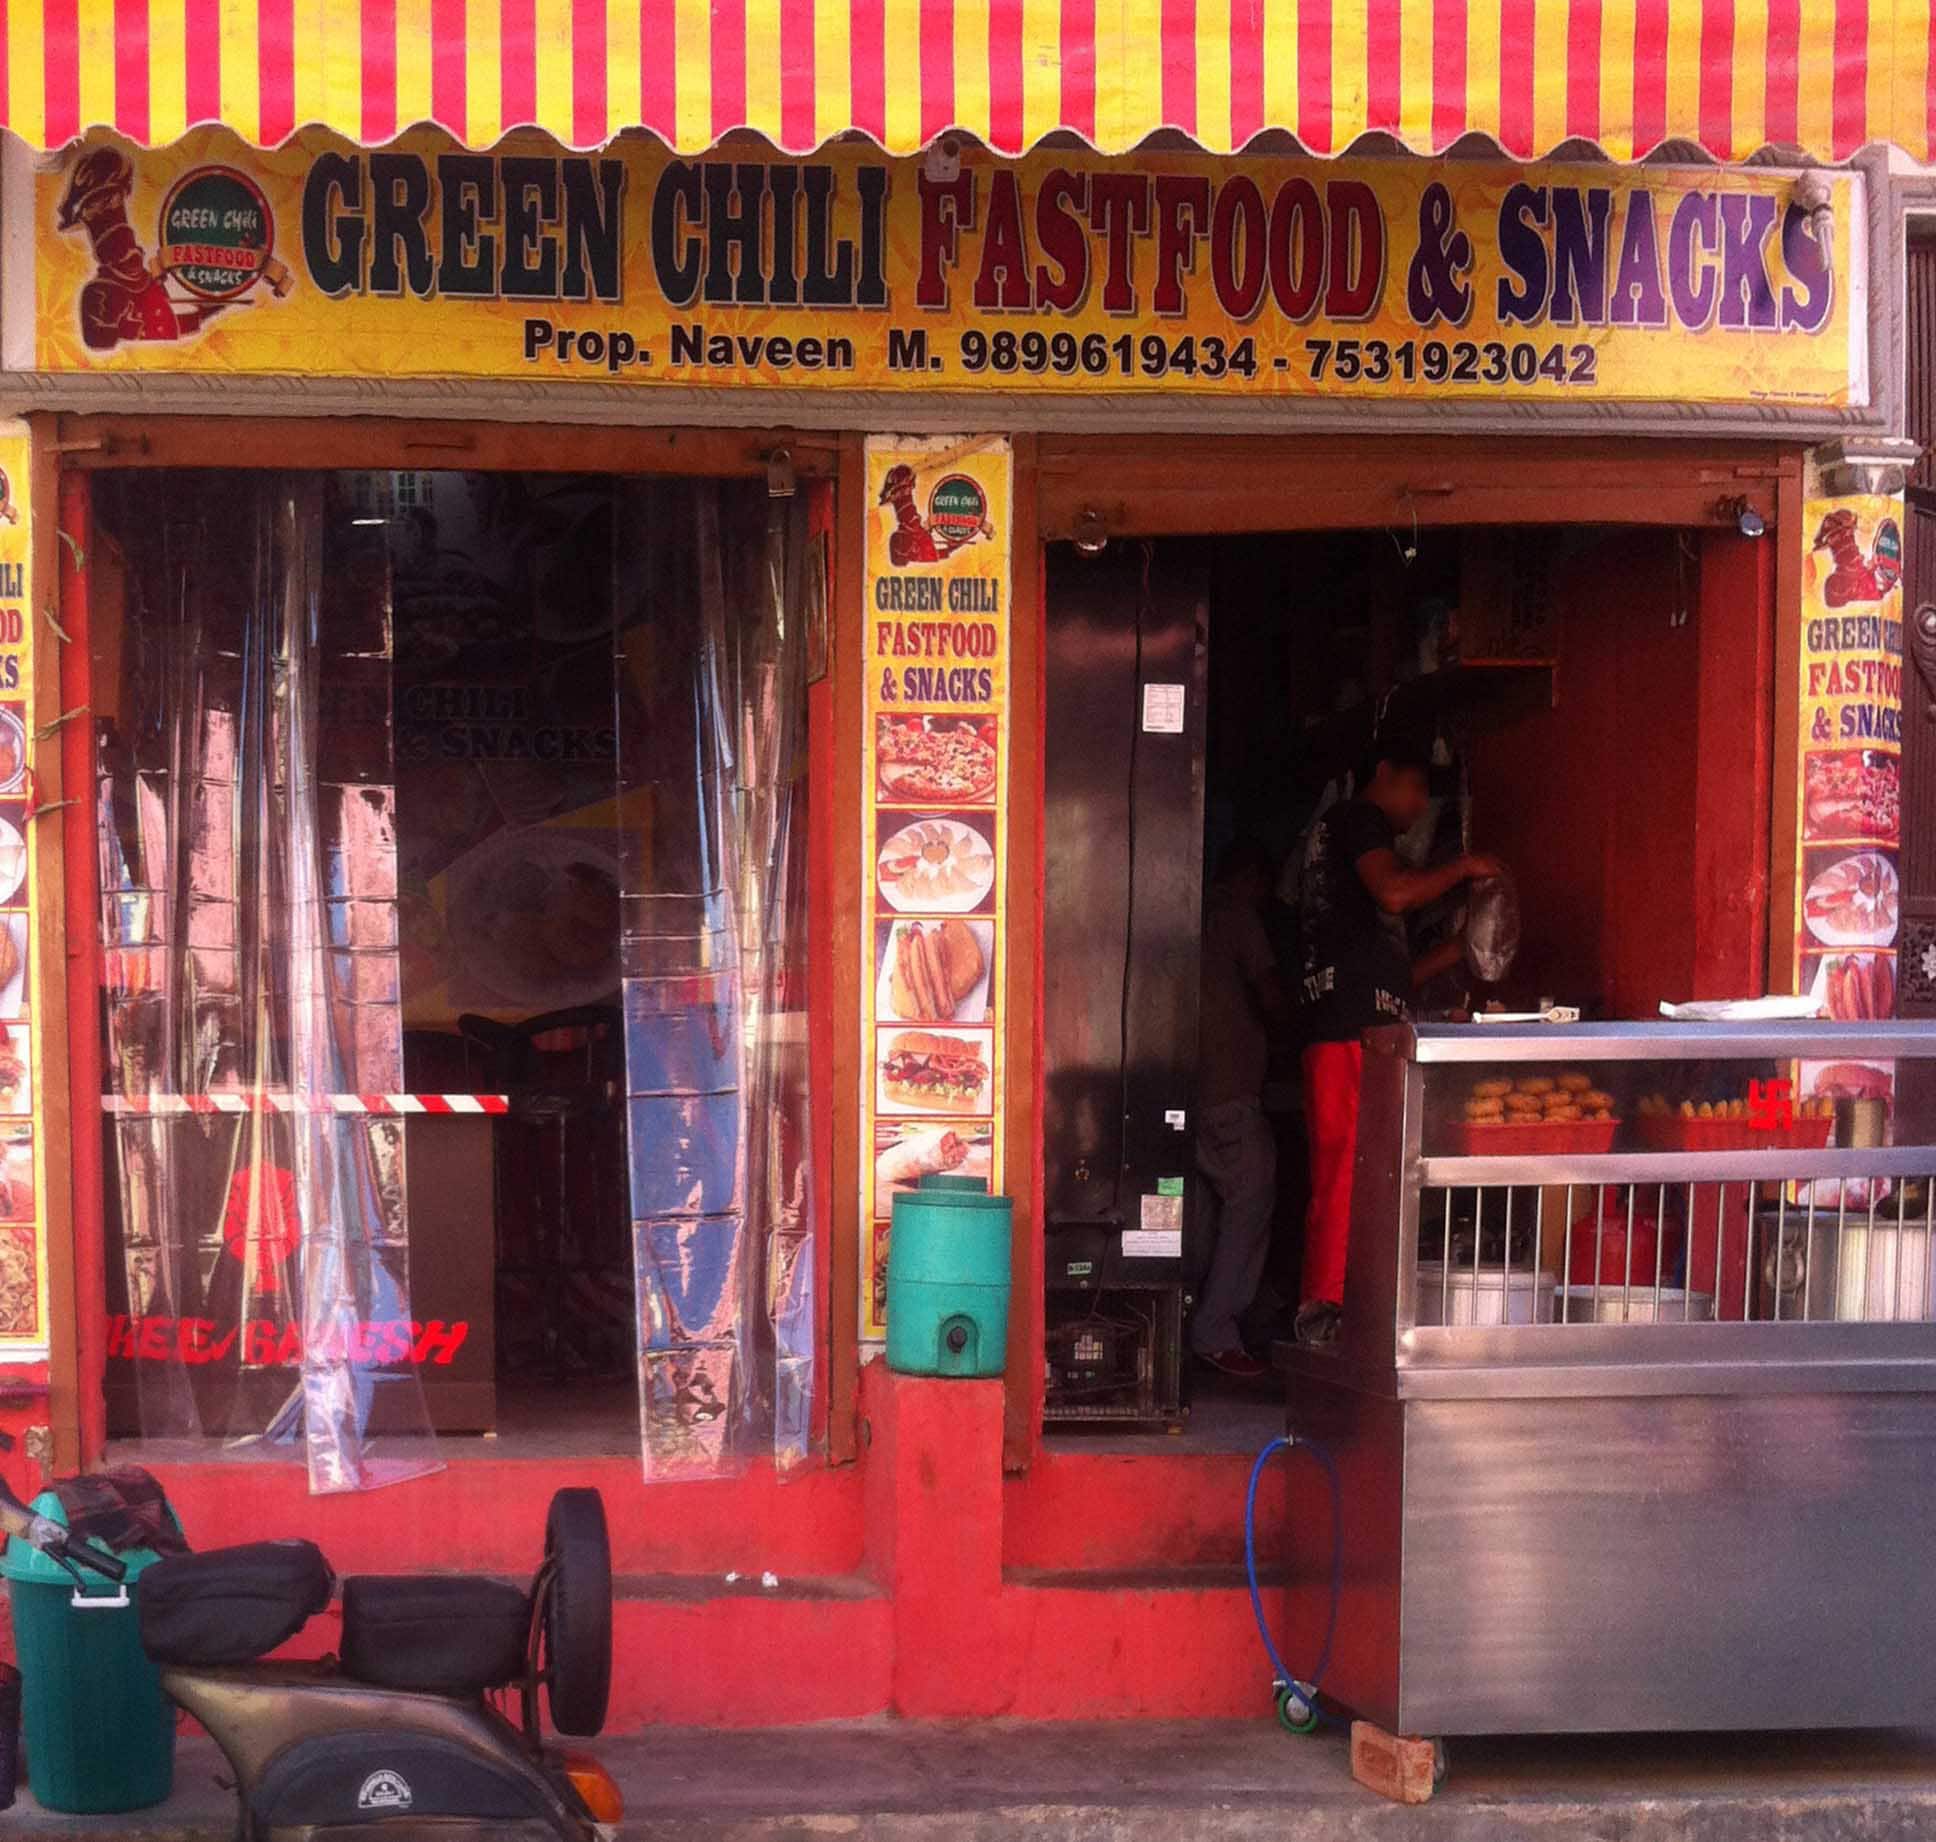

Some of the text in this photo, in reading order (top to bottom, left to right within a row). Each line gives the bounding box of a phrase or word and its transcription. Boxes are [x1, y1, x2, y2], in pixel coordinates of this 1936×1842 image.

[171, 207, 218, 230] GREEN
[173, 245, 257, 268] FASTFOOD
[302, 152, 1836, 334] GREEN CHILI FASTFOOD & SNACKS
[187, 266, 244, 285] & SNACKS
[523, 320, 651, 373] Prop.
[670, 325, 854, 368] Naveen
[887, 329, 943, 370] M.
[961, 330, 1257, 379] 9899619434
[1304, 340, 1597, 385] 7531923042
[875, 576, 998, 614] GREEN CHILI
[877, 621, 997, 657] FASTFOOD
[1807, 615, 1881, 652] GREEN
[405, 685, 528, 720] CHILI
[880, 667, 992, 704] & SNACKS
[1811, 706, 1831, 740] &
[441, 725, 615, 760] SNACKS
